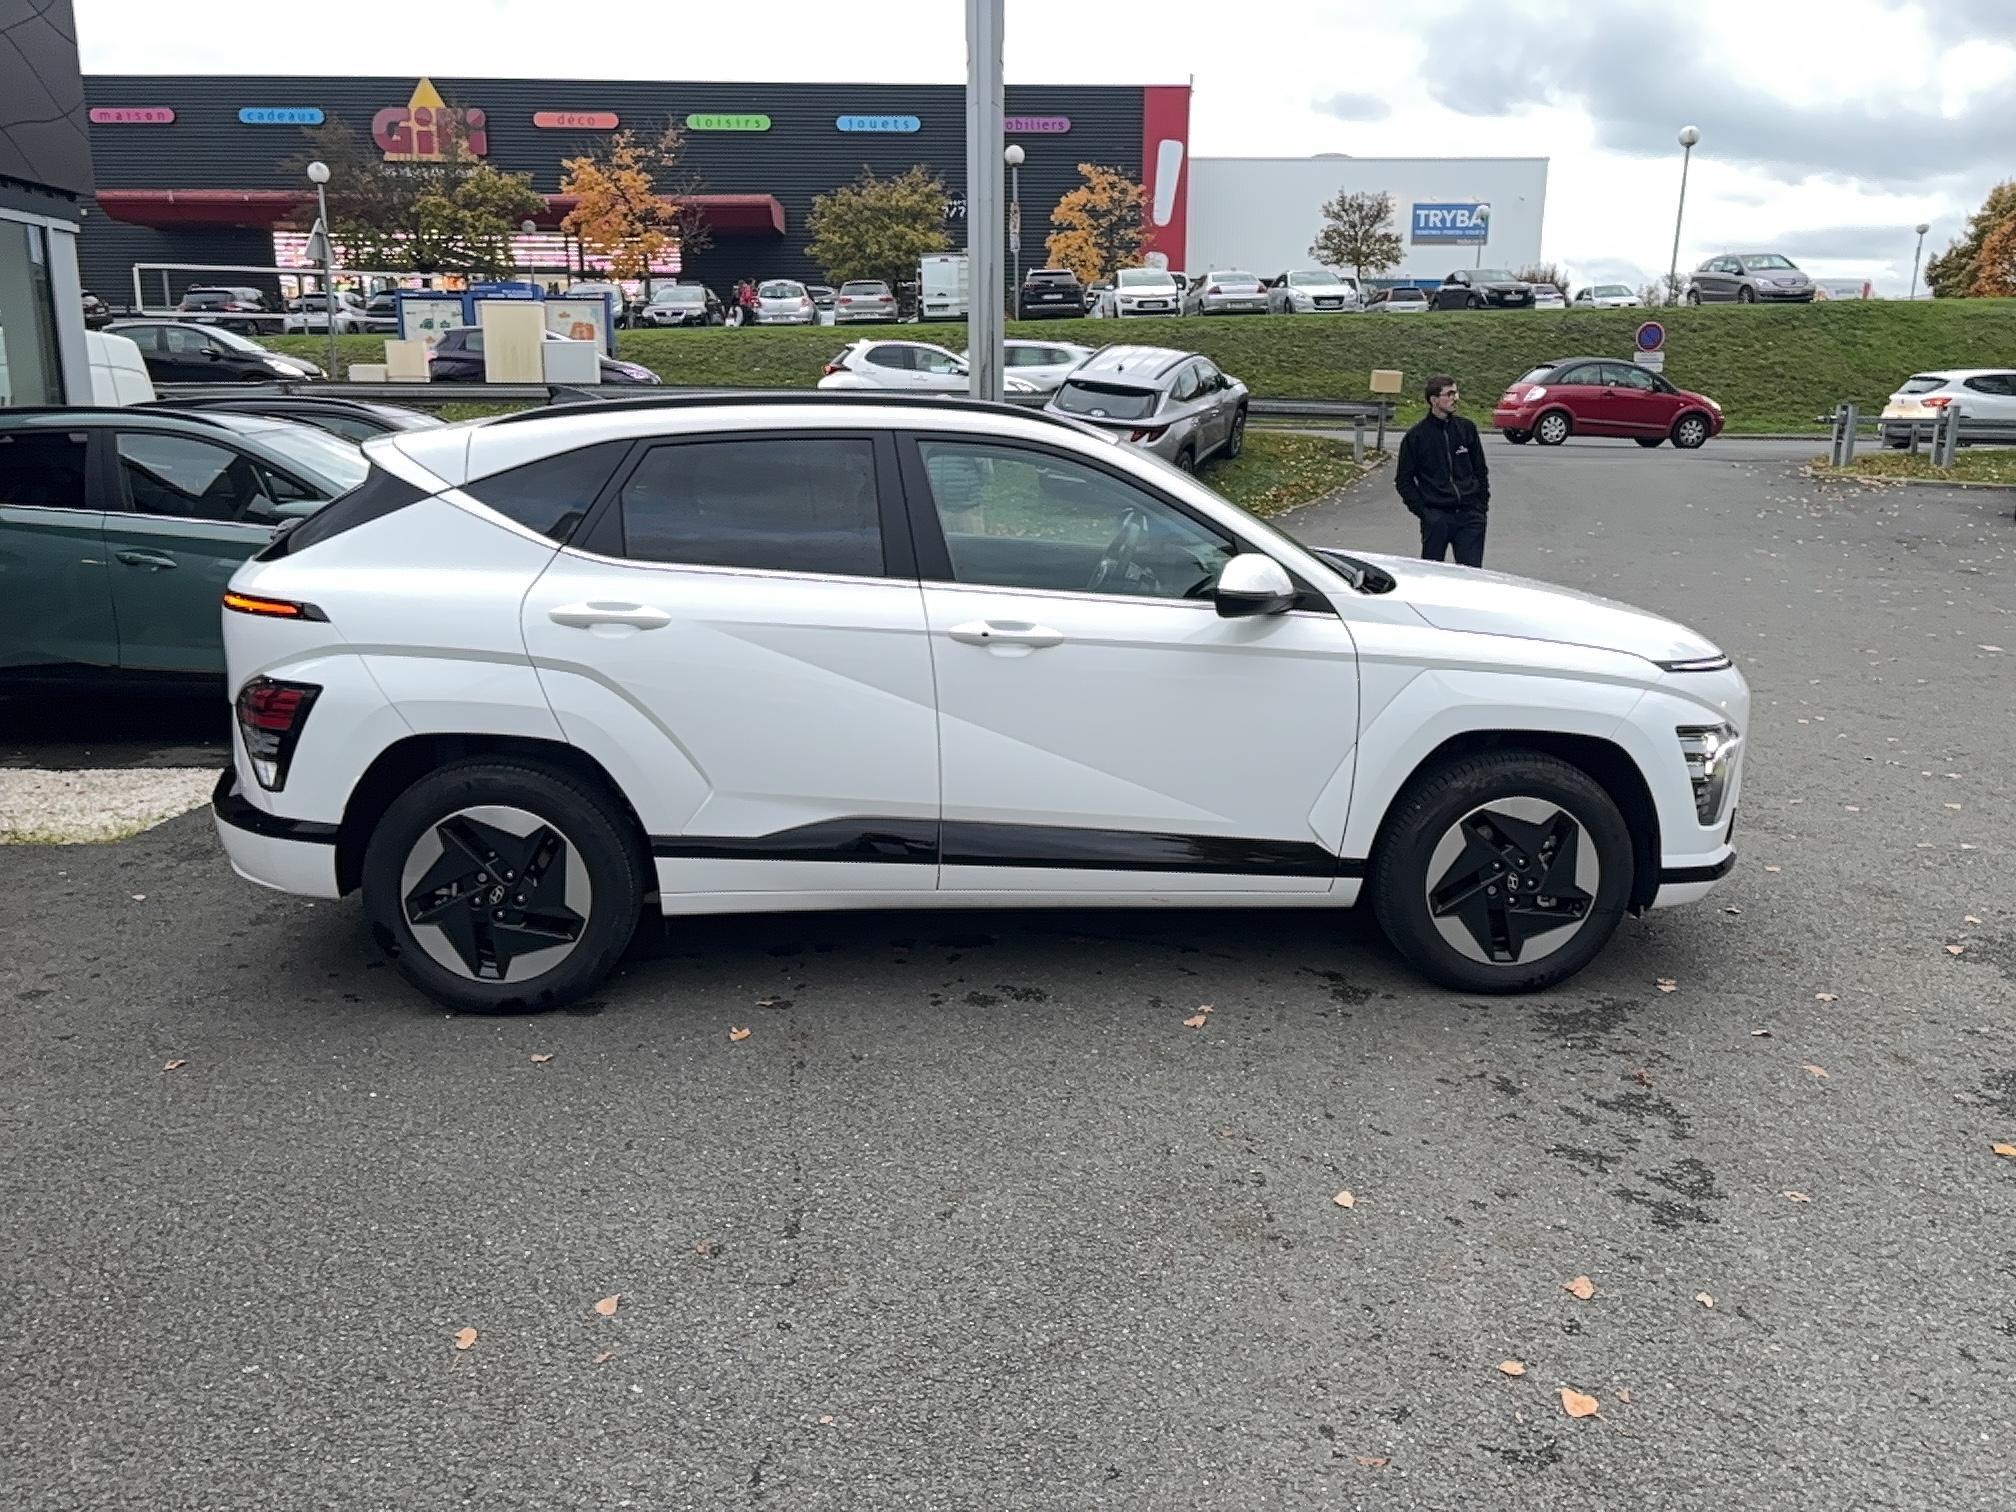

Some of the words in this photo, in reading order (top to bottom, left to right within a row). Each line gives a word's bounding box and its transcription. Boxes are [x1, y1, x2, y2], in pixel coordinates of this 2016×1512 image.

[100, 111, 166, 121] maison
[246, 109, 316, 121] cadeaux
[557, 114, 596, 127] déco
[696, 115, 762, 129] loisirs
[849, 117, 910, 132] jouets
[1005, 117, 1065, 131] obiliers
[1416, 209, 1486, 228] TRYBA
